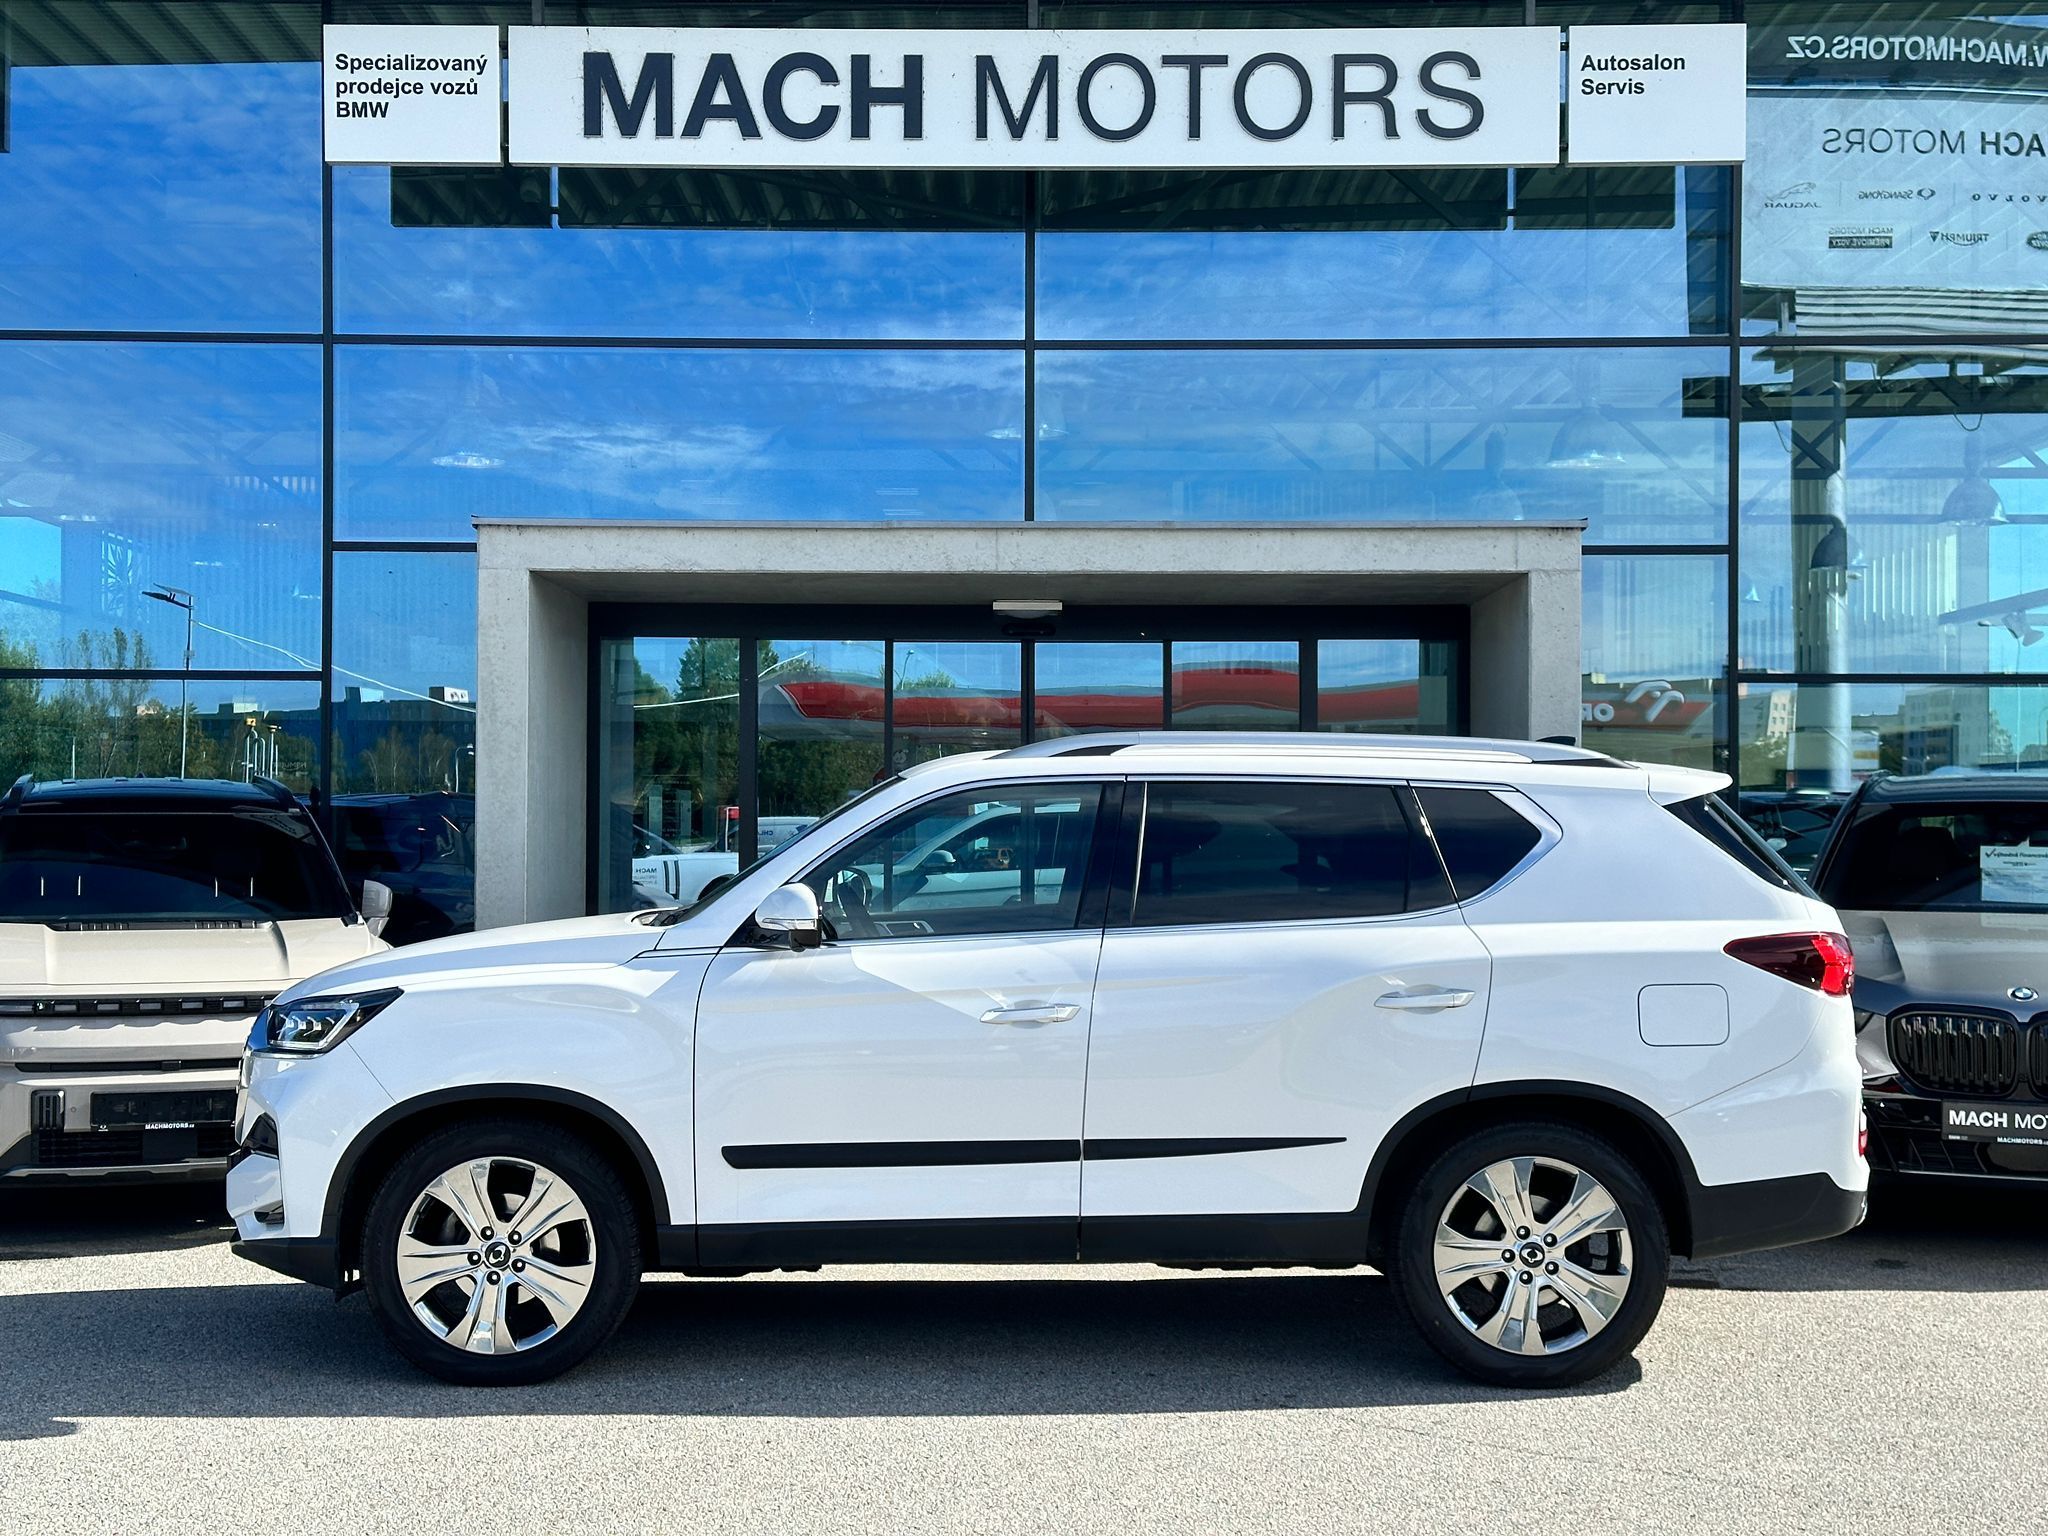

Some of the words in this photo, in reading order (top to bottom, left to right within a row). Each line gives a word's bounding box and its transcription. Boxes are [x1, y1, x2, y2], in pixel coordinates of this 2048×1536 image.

[335, 54, 488, 75] Specializovaný
[1581, 54, 1686, 72] Autosalon
[336, 78, 424, 98] prodejce
[430, 78, 478, 95] vozů
[583, 51, 924, 141] MACH
[975, 51, 1484, 142] MOTORS
[1581, 79, 1645, 95] Servis
[336, 101, 389, 118] BMW
[1949, 1109, 2008, 1128] MACH
